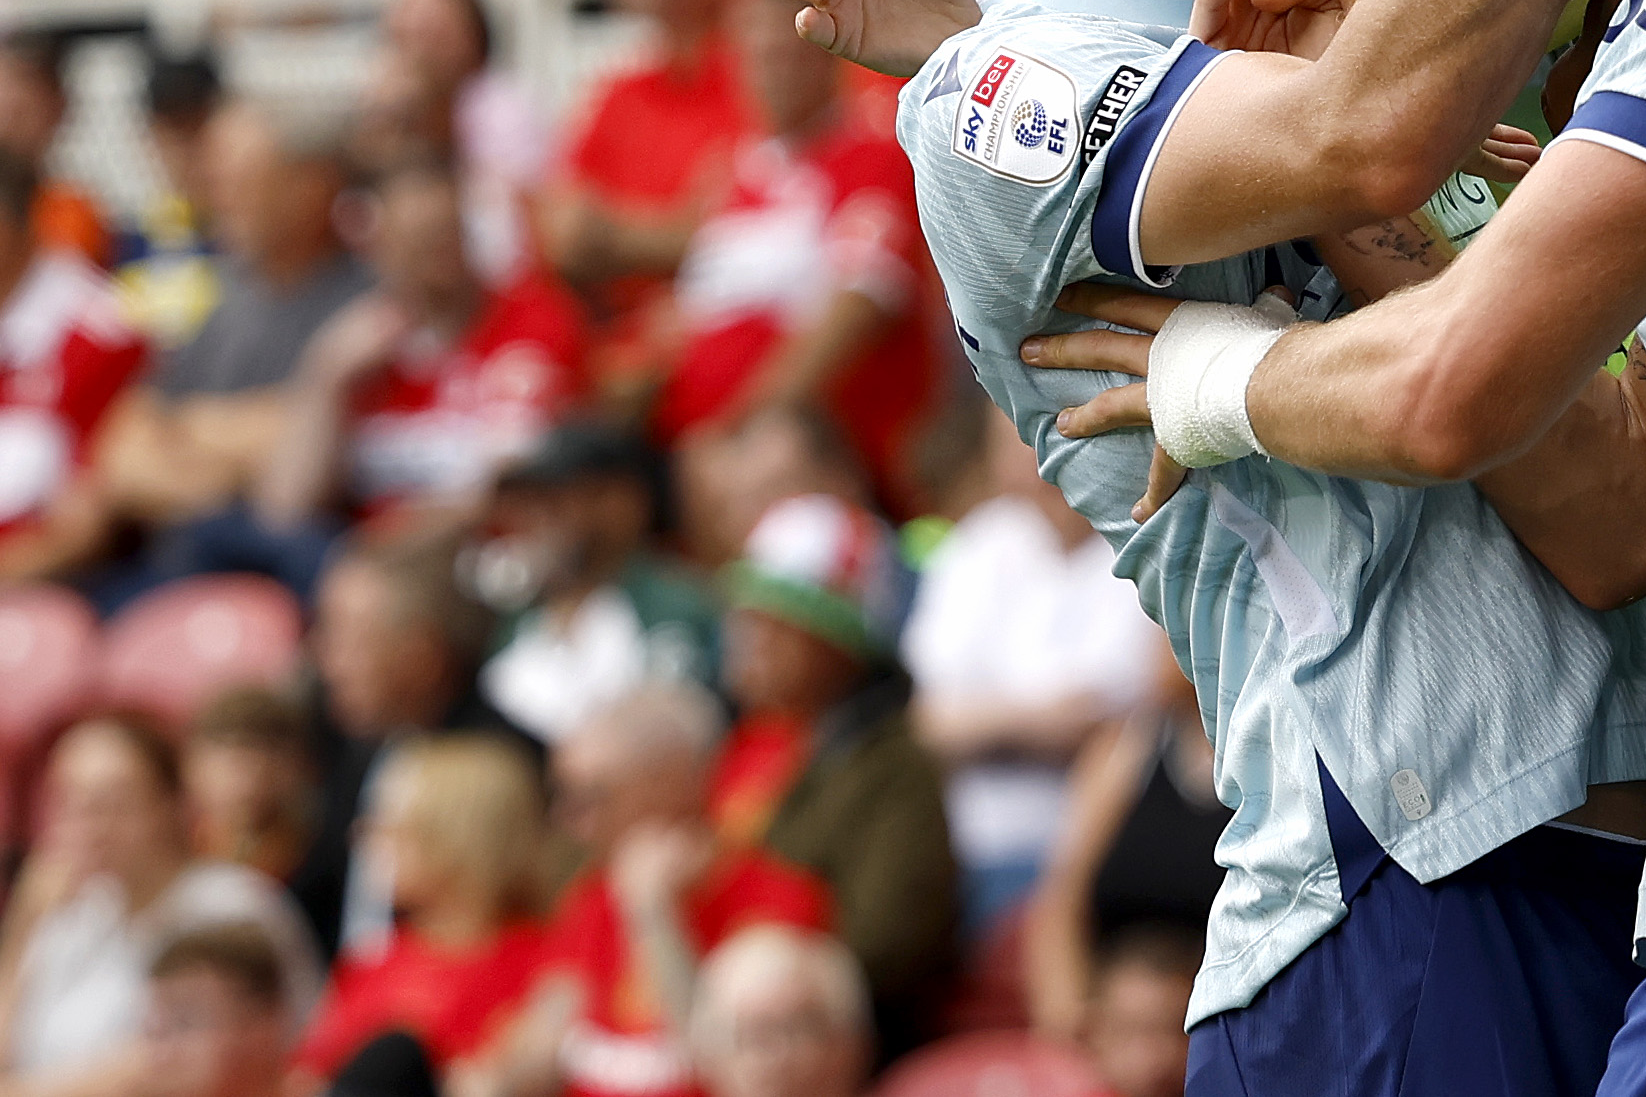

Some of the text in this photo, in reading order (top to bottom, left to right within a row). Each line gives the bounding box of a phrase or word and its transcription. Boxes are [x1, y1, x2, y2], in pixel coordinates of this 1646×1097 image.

[962, 59, 1010, 153] sky bet
[984, 62, 1025, 161] CHAMPIONSHIP
[1047, 117, 1068, 155] EFL
